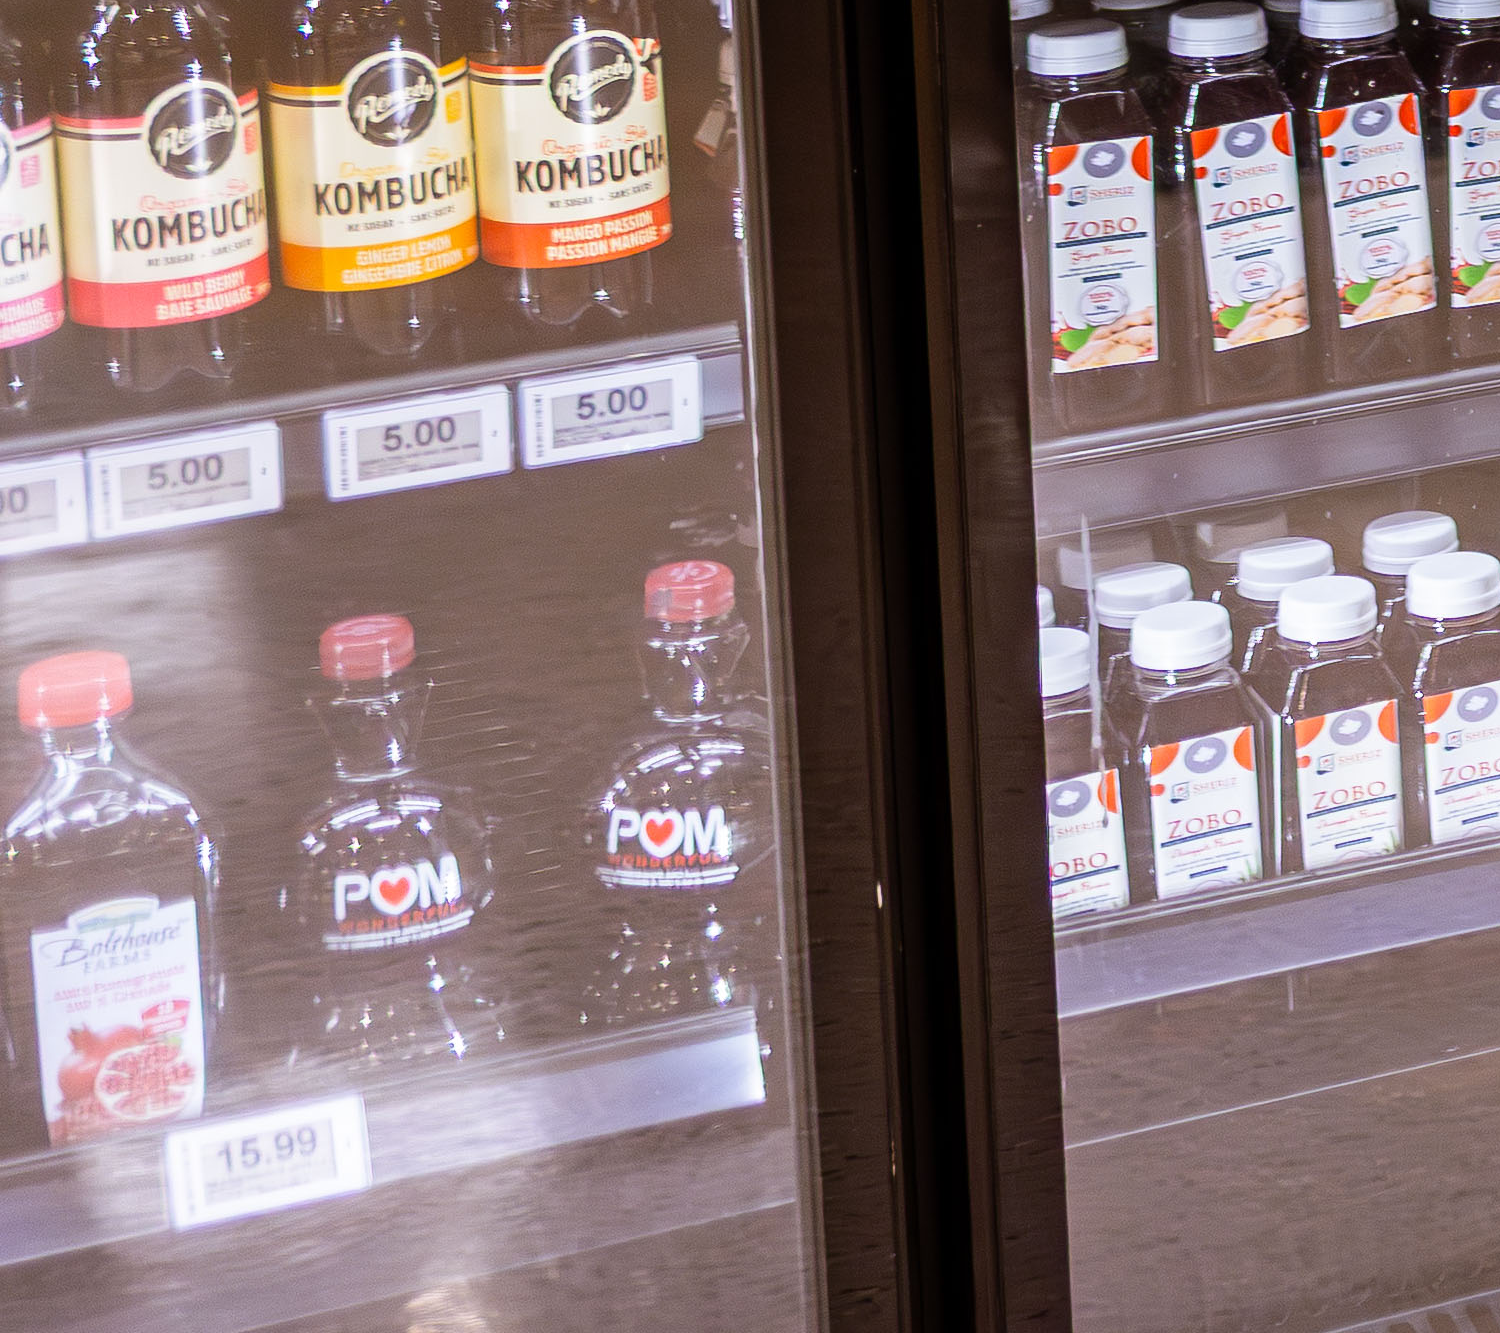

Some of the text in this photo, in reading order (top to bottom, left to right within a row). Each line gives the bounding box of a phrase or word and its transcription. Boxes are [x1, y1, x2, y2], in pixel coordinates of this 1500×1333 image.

[515, 134, 665, 194] KOMBUCHA
[314, 156, 470, 216] KOMBUCHA
[1338, 171, 1411, 199] ZOBO
[112, 188, 266, 252] KOMBUCHA
[1210, 193, 1284, 222] ZOBO
[551, 209, 653, 243] MANGO PASSION
[1063, 215, 1138, 240] ZOBO
[356, 236, 451, 264] GINGER LEMON
[545, 229, 660, 261] PASSION MANGUE
[205, 269, 246, 295] BERRY
[576, 384, 648, 419] 5.00
[382, 417, 458, 451] 5.00
[148, 452, 223, 488] 5.00
[1313, 781, 1386, 811] ZOBO
[607, 806, 730, 858] POM
[1166, 809, 1242, 839] ZOBO
[334, 854, 462, 921] POM
[39, 923, 181, 968] Bolthouse
[217, 1127, 318, 1173] 15.99
